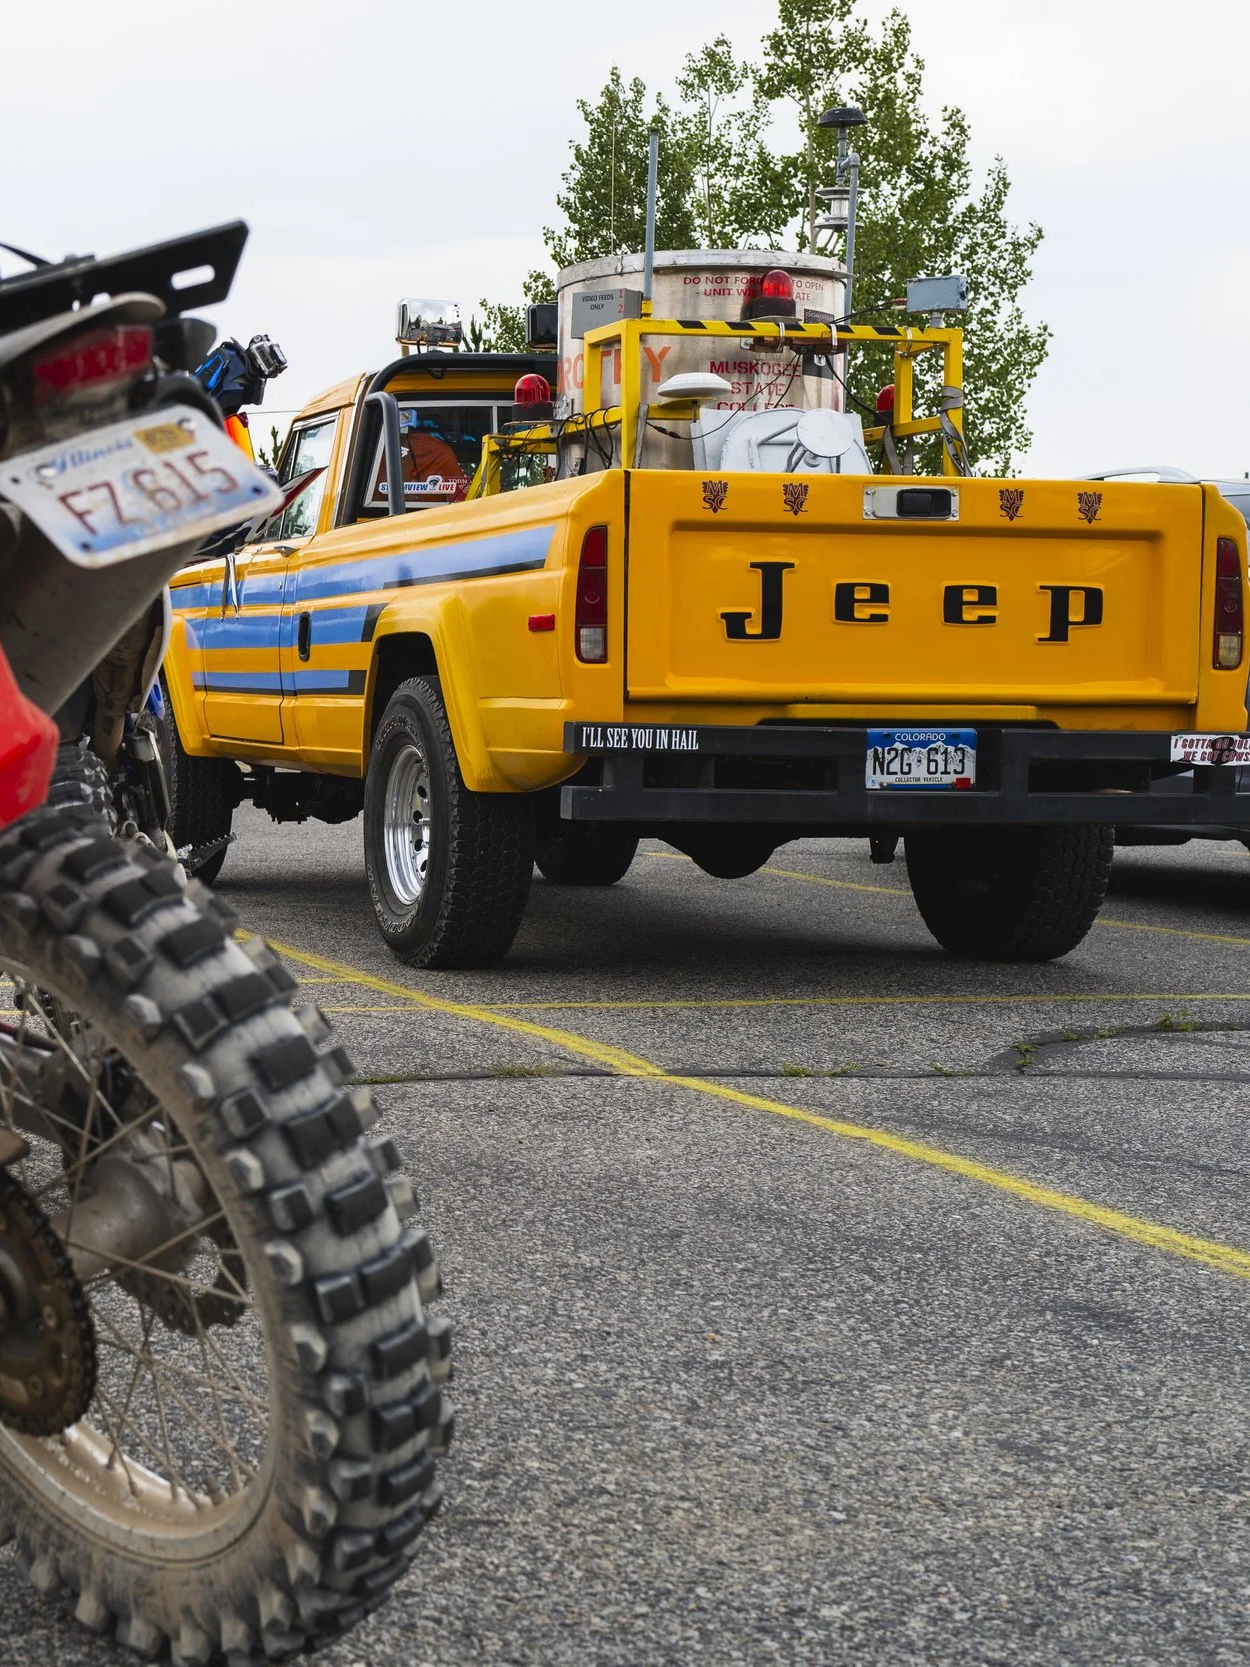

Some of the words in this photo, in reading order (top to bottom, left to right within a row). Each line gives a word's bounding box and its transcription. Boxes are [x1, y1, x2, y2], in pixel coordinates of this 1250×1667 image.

[683, 276, 701, 285] DO
[705, 276, 731, 285] NOT
[792, 280, 803, 289] TO
[805, 281, 824, 291] OPEN
[598, 293, 614, 301] FEEDS
[704, 288, 733, 296] UNIT
[617, 304, 623, 313] 2
[710, 360, 802, 377] MUSKOGEE
[730, 381, 786, 396] STATE
[57, 480, 150, 536] FZ
[130, 450, 241, 513] 615
[381, 483, 428, 491] SMVIEW
[438, 483, 455, 491] LIVE
[719, 561, 1104, 642] Jeep
[582, 726, 604, 748] I'LL
[606, 727, 629, 748] SEE
[631, 728, 654, 749] YOU
[655, 729, 669, 749] IN
[671, 729, 699, 750] HAIL
[894, 732, 946, 741] COLORADO
[1173, 738, 1178, 749] I
[1181, 738, 1213, 749] GOTTA
[1231, 738, 1250, 750] JUL
[872, 747, 912, 775] N2G
[926, 747, 966, 775] 613
[1183, 750, 1198, 761] WE
[1200, 750, 1220, 762] GOT
